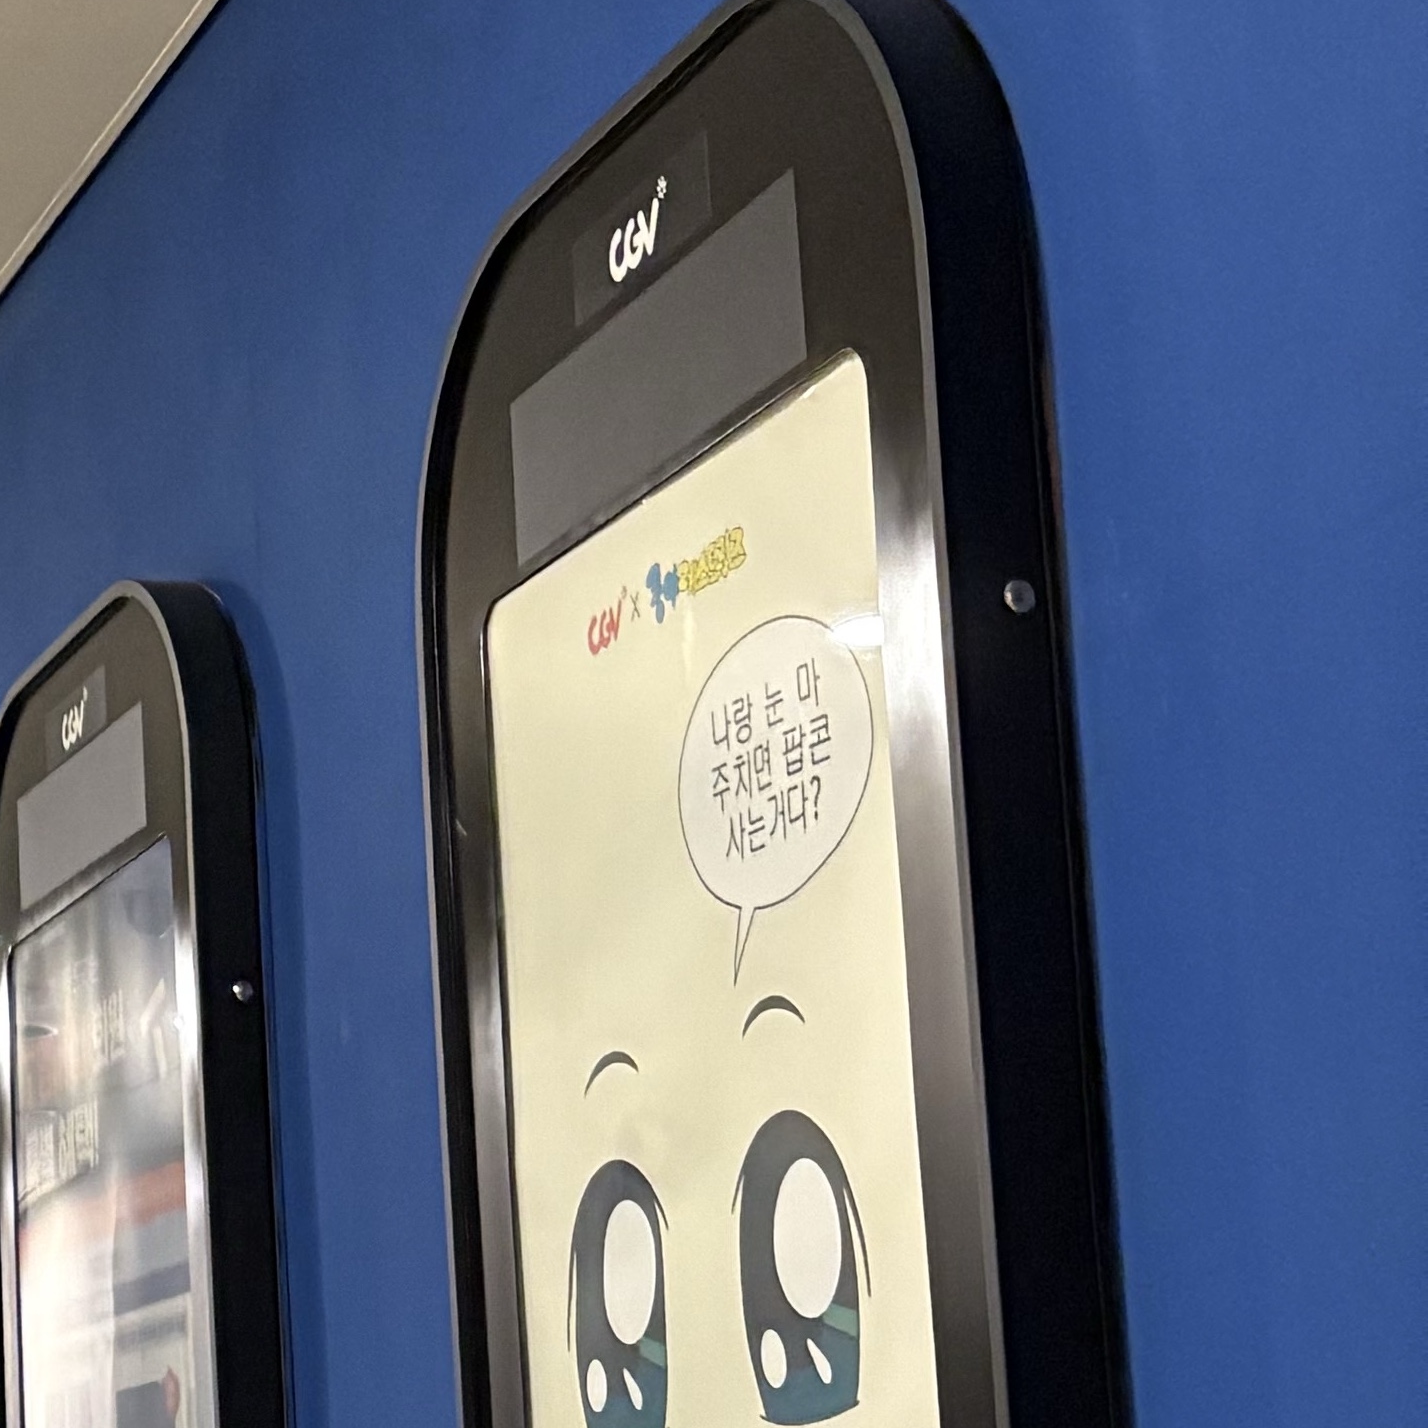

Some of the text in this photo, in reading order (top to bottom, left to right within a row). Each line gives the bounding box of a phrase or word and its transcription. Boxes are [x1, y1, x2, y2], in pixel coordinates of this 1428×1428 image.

[609, 197, 660, 283] CGV
[588, 594, 623, 656] CGV
[62, 699, 85, 751] CGV
[711, 657, 821, 752] 나랑 눈 마
[711, 713, 832, 813] 주치면 팝콘
[725, 774, 822, 863] 사는거다?
